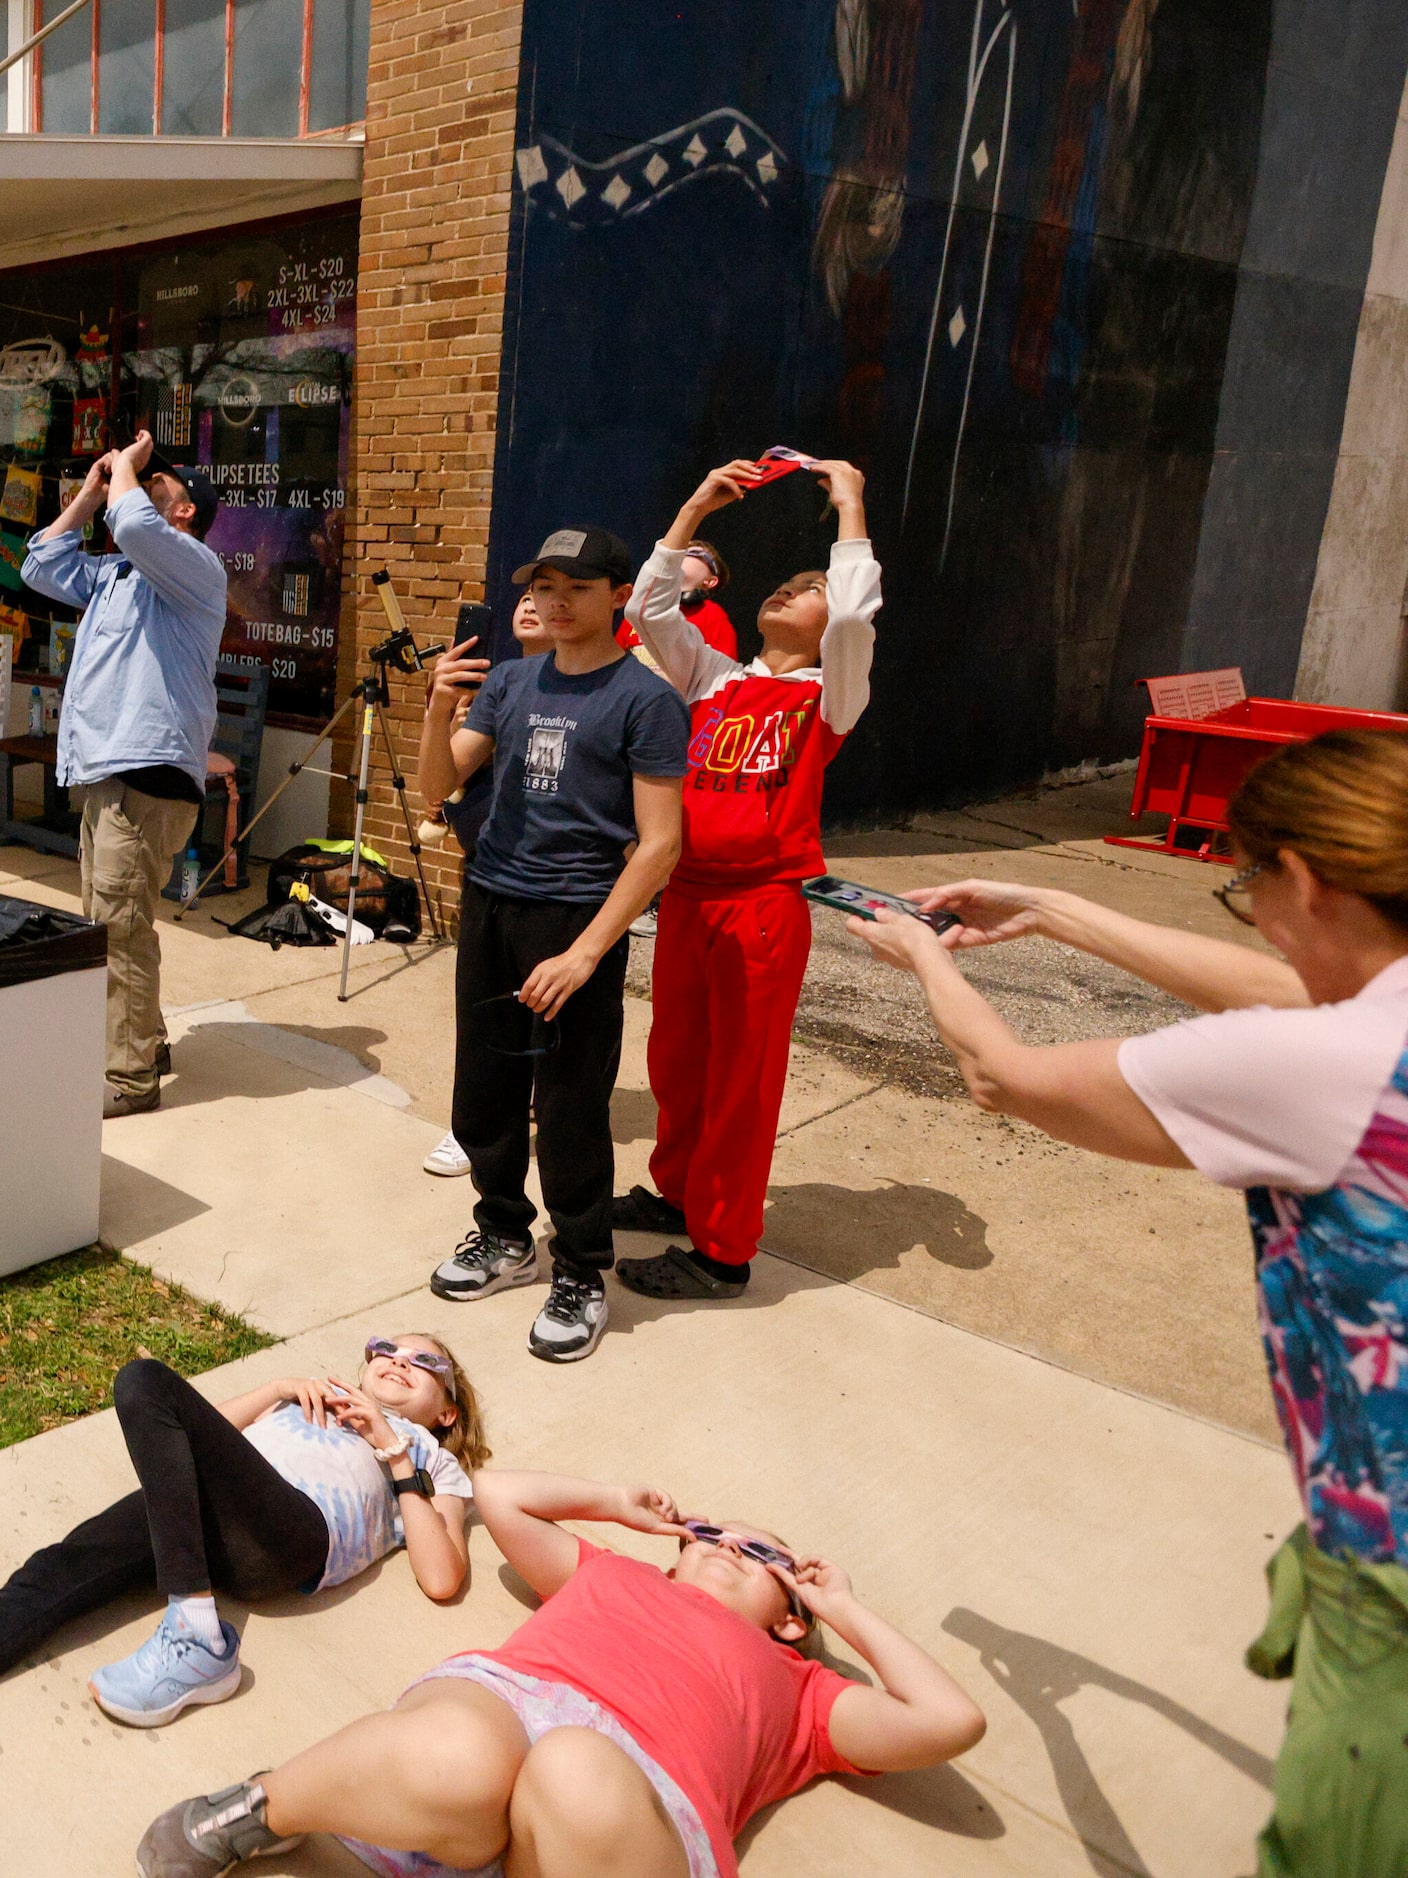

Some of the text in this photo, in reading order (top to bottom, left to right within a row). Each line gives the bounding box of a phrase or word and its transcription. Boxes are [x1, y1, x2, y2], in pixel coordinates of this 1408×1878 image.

[156, 285, 199, 301] HILLSBORO
[527, 713, 578, 731] Brooklyn
[687, 699, 814, 773] GOAT
[686, 769, 789, 793] EGEND
